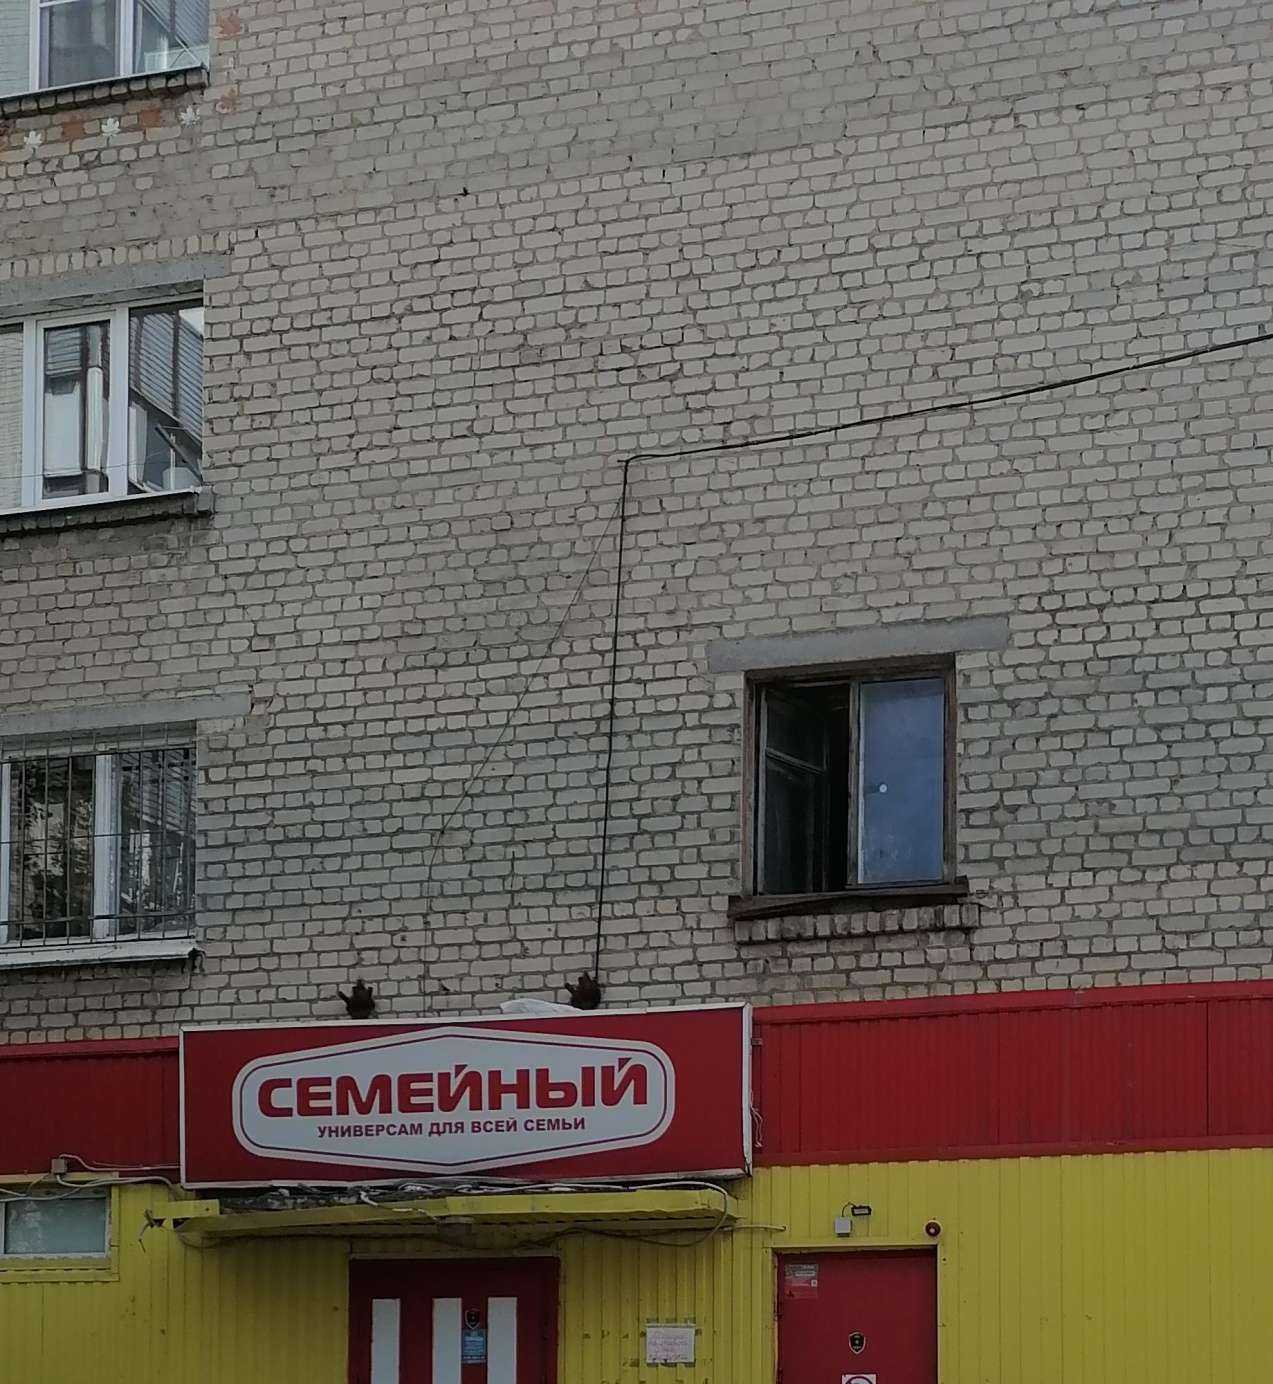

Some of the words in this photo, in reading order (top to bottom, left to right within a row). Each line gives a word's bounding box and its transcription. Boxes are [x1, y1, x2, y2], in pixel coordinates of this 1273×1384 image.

[258, 1057, 648, 1118] СЕМЕЙНЫЙ
[317, 1121, 423, 1138] УНИВЕРСАМ
[428, 1121, 464, 1137] ДЛЯ
[471, 1116, 517, 1134] ВСЕЙ
[524, 1118, 586, 1132] СЕМЬИ
